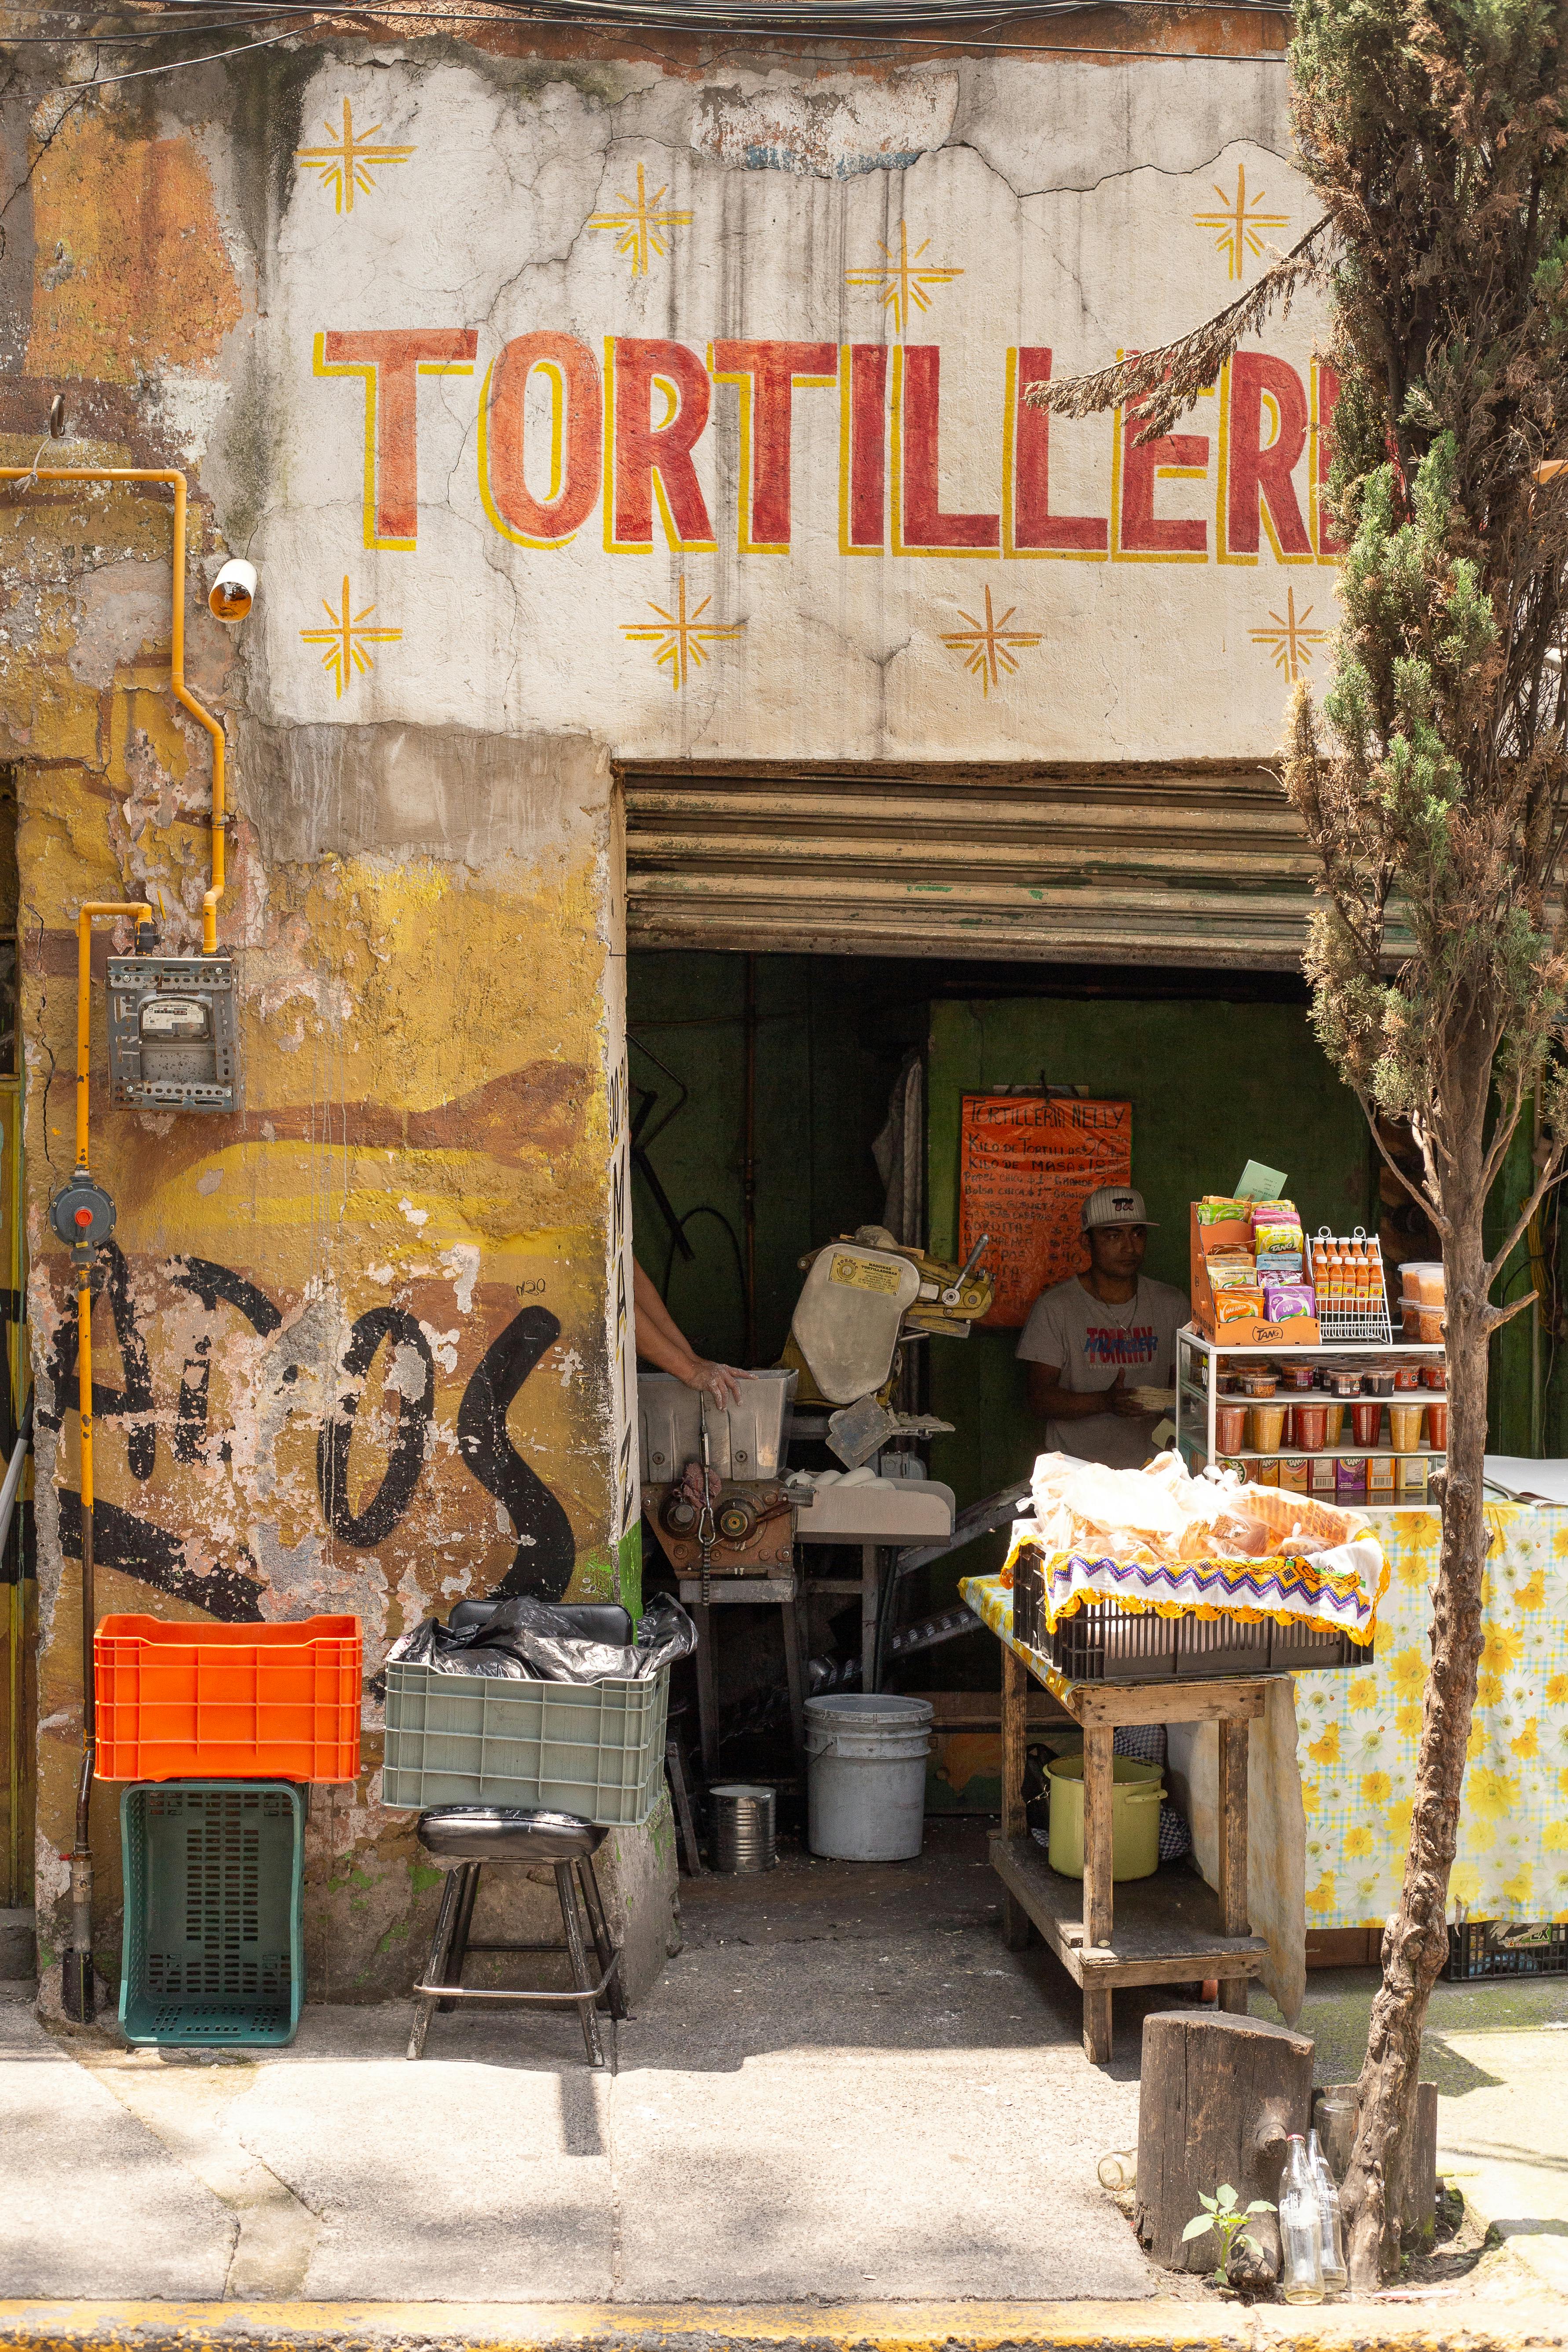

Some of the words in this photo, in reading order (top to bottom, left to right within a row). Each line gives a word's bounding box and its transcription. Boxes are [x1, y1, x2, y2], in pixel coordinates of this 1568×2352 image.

[314, 328, 1416, 565] TORTILLERI
[965, 1100, 1065, 1129] TORTILLERIA
[1072, 1104, 1126, 1130] NELLY
[969, 1132, 999, 1153] KILO
[1003, 1144, 1020, 1153] DE
[969, 1156, 999, 1170] KILO
[1003, 1160, 1019, 1169] DE
[1032, 1160, 1075, 1172] MASA
[1270, 1240, 1294, 1251] TANG
[861, 1265, 898, 1276] TORTILLADORAS
[1225, 1304, 1247, 1314] NARANJA
[1283, 1304, 1294, 1313] UVA
[1257, 1329, 1280, 1341] TANG
